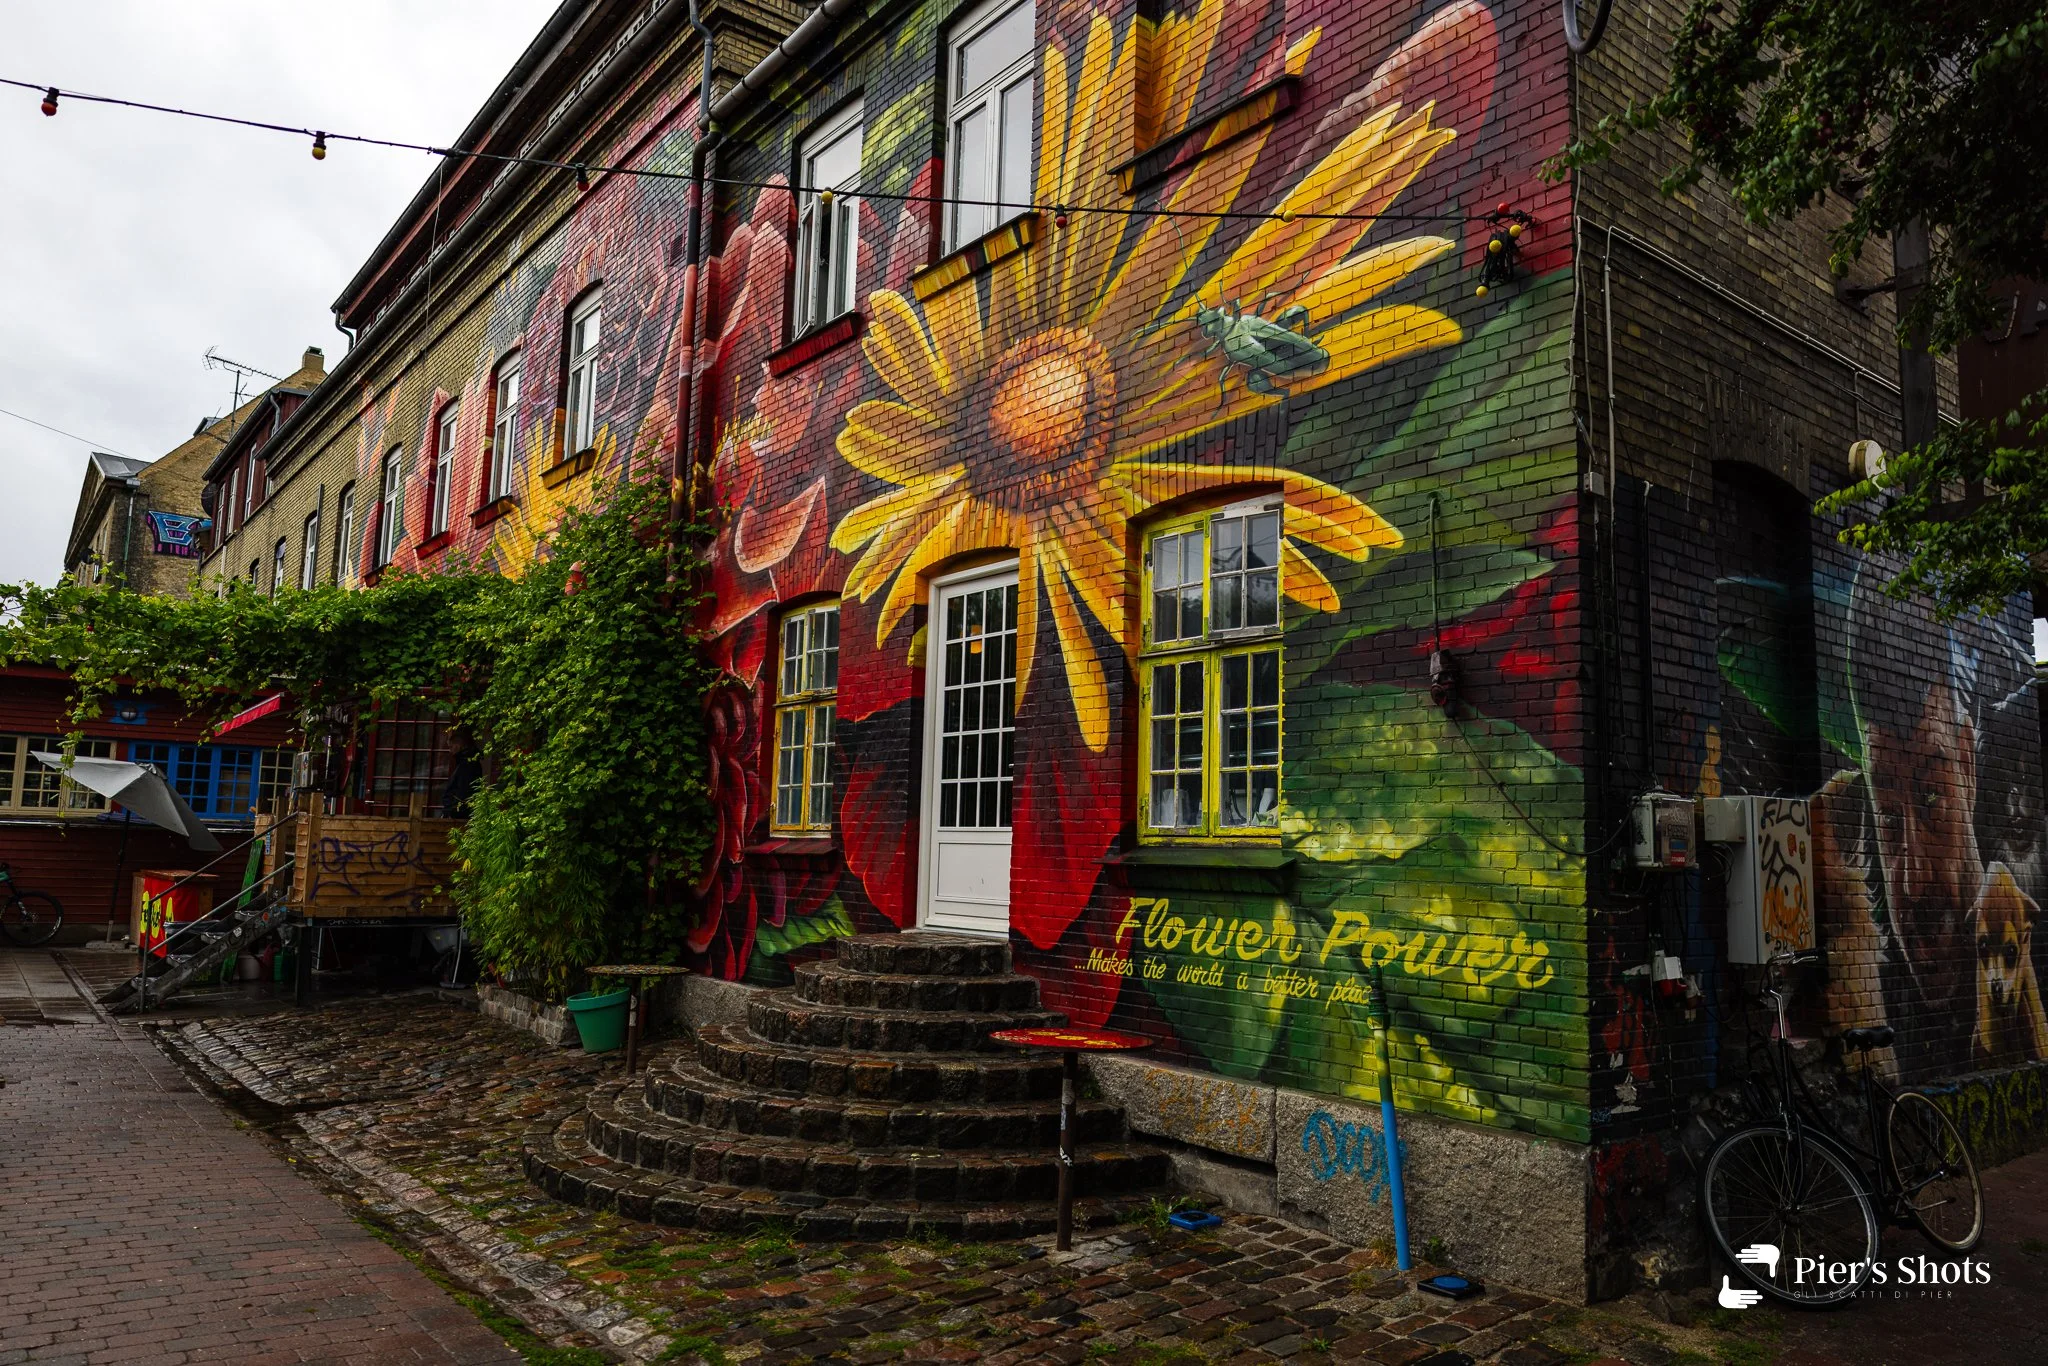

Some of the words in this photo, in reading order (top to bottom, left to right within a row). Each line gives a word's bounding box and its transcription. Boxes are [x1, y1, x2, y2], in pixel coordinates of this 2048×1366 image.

[1115, 896, 1303, 962] Flower
[1319, 909, 1554, 989] Power
[1142, 955, 1167, 980] the
[1176, 961, 1225, 987] world
[1235, 971, 1249, 991] a
[1262, 967, 1319, 998] better
[1325, 975, 1373, 1011] plac
